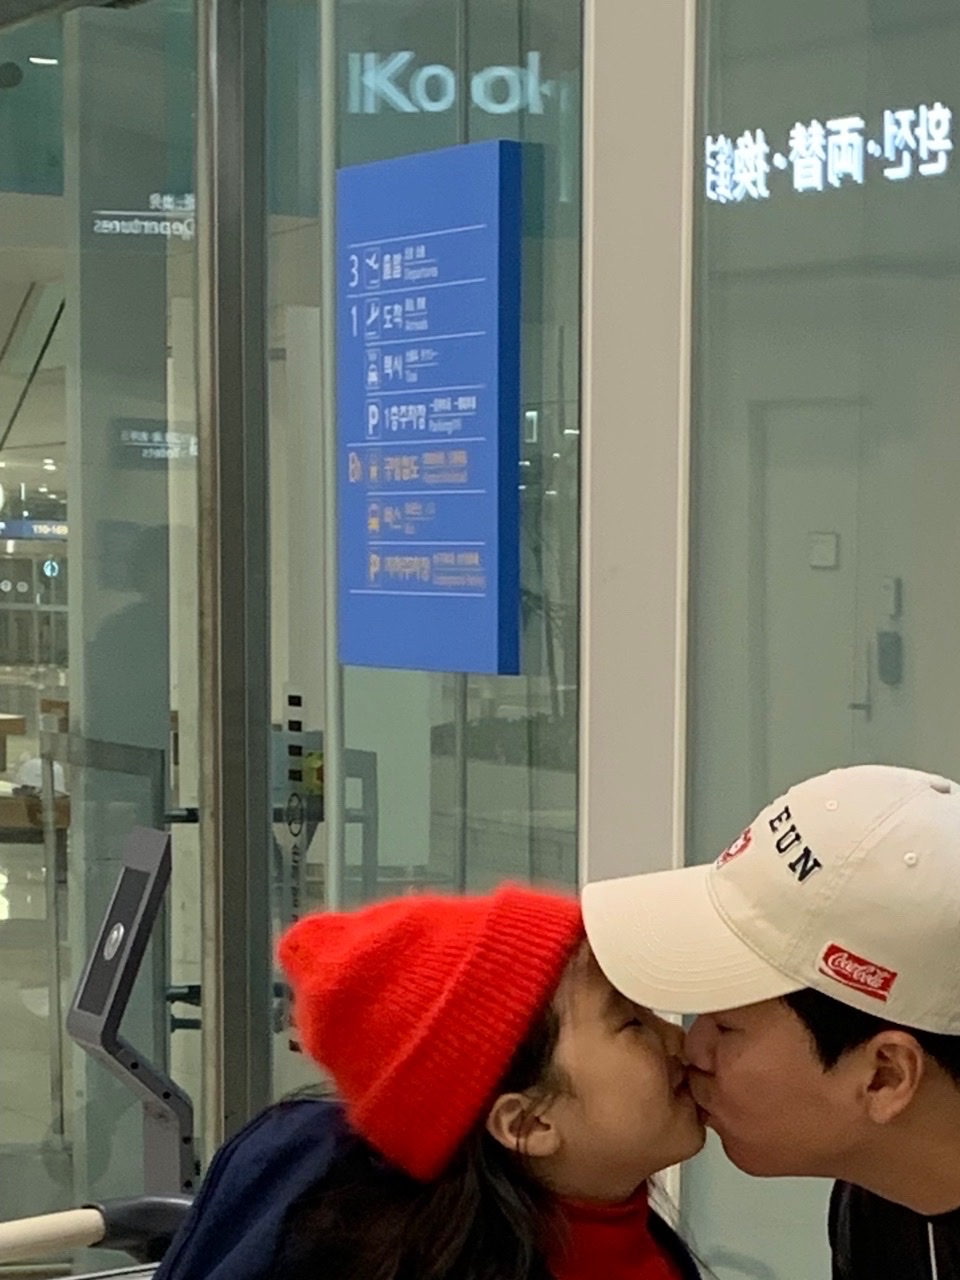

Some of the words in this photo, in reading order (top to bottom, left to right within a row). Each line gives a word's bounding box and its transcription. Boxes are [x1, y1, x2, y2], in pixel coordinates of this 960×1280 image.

[348, 254, 359, 287] 3
[350, 304, 359, 338] 1
[768, 805, 824, 883] EUN
